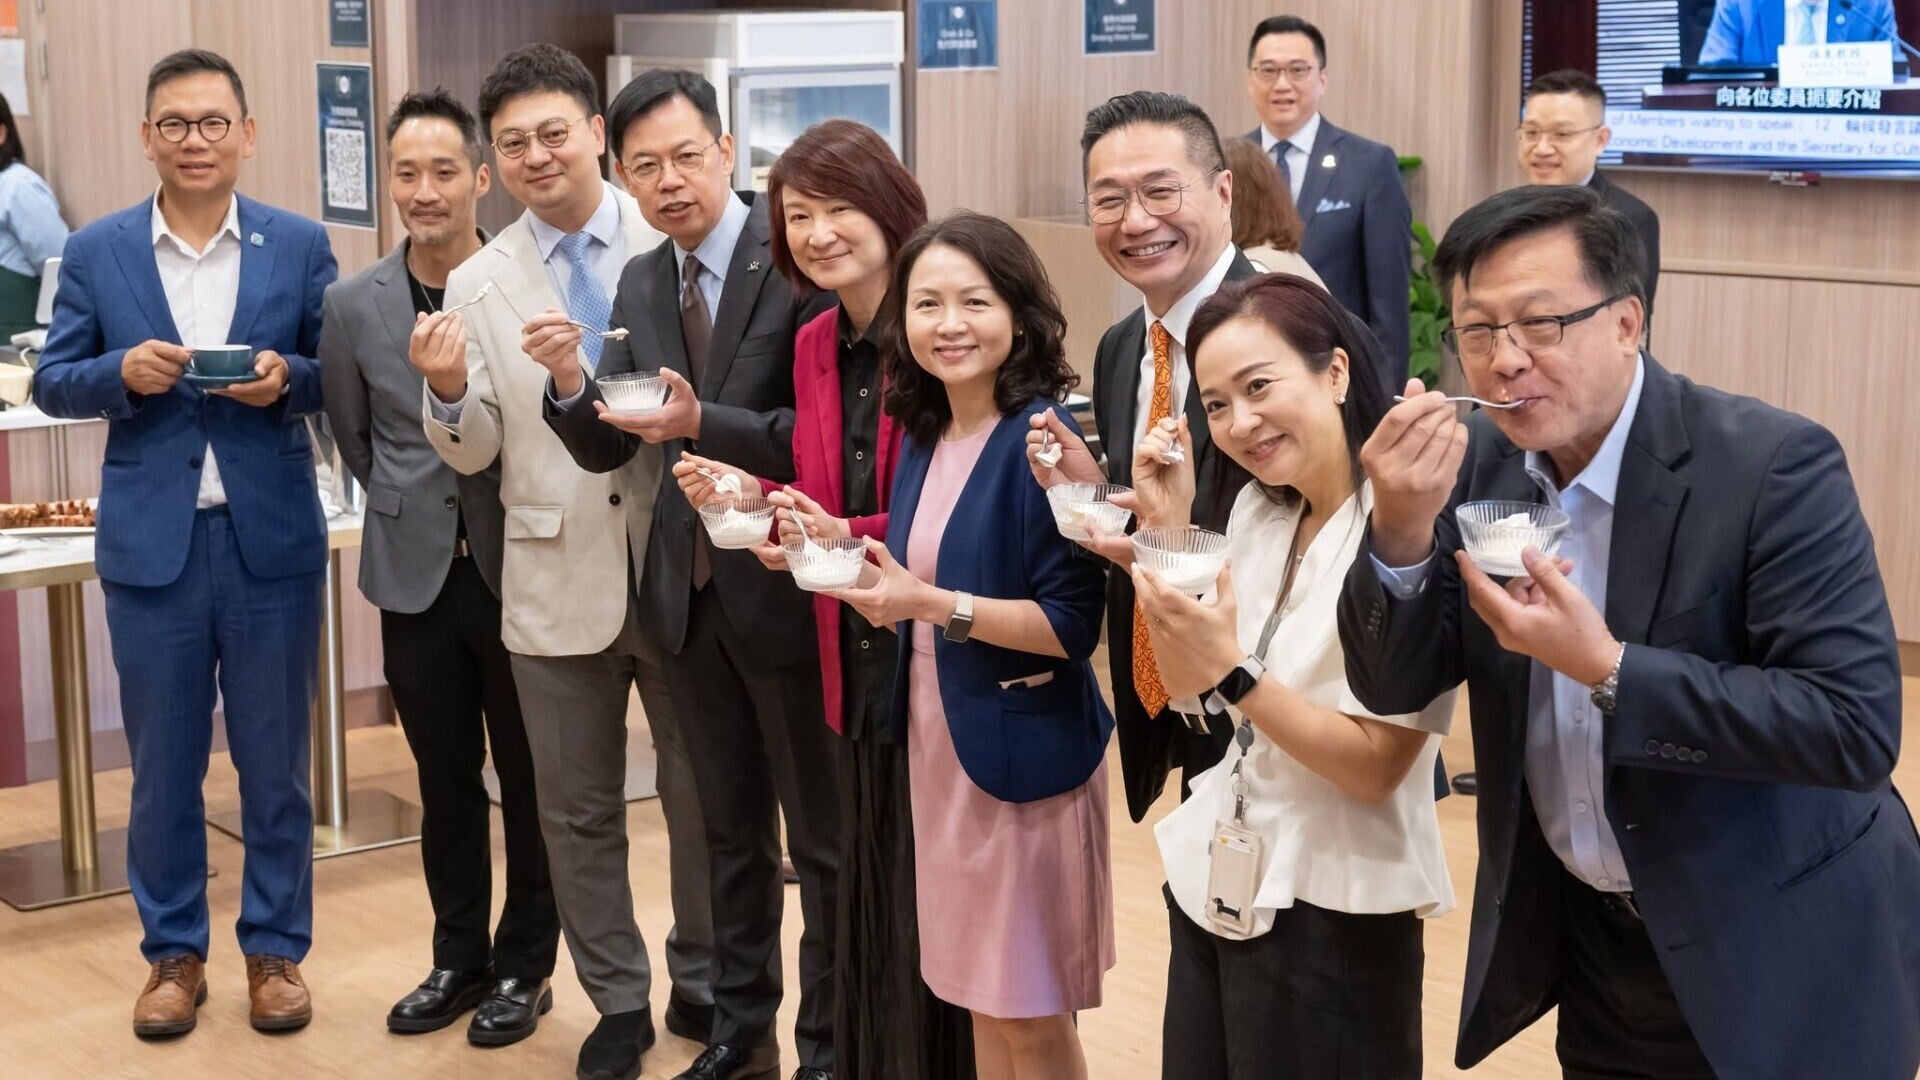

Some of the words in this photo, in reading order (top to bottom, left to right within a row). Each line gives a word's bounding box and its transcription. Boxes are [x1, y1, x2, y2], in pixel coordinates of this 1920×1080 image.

[1716, 85, 1882, 110] 向各位委員扼要介紹
[1611, 113, 1624, 125] of
[1629, 113, 1686, 127] Members
[1690, 116, 1735, 131] waiting
[1740, 118, 1754, 129] to
[1758, 118, 1794, 132] speak
[1662, 135, 1743, 150] Development
[1749, 139, 1773, 151] and
[1777, 140, 1798, 152] the
[1802, 139, 1863, 155] Secretary
[1869, 142, 1888, 154] for
